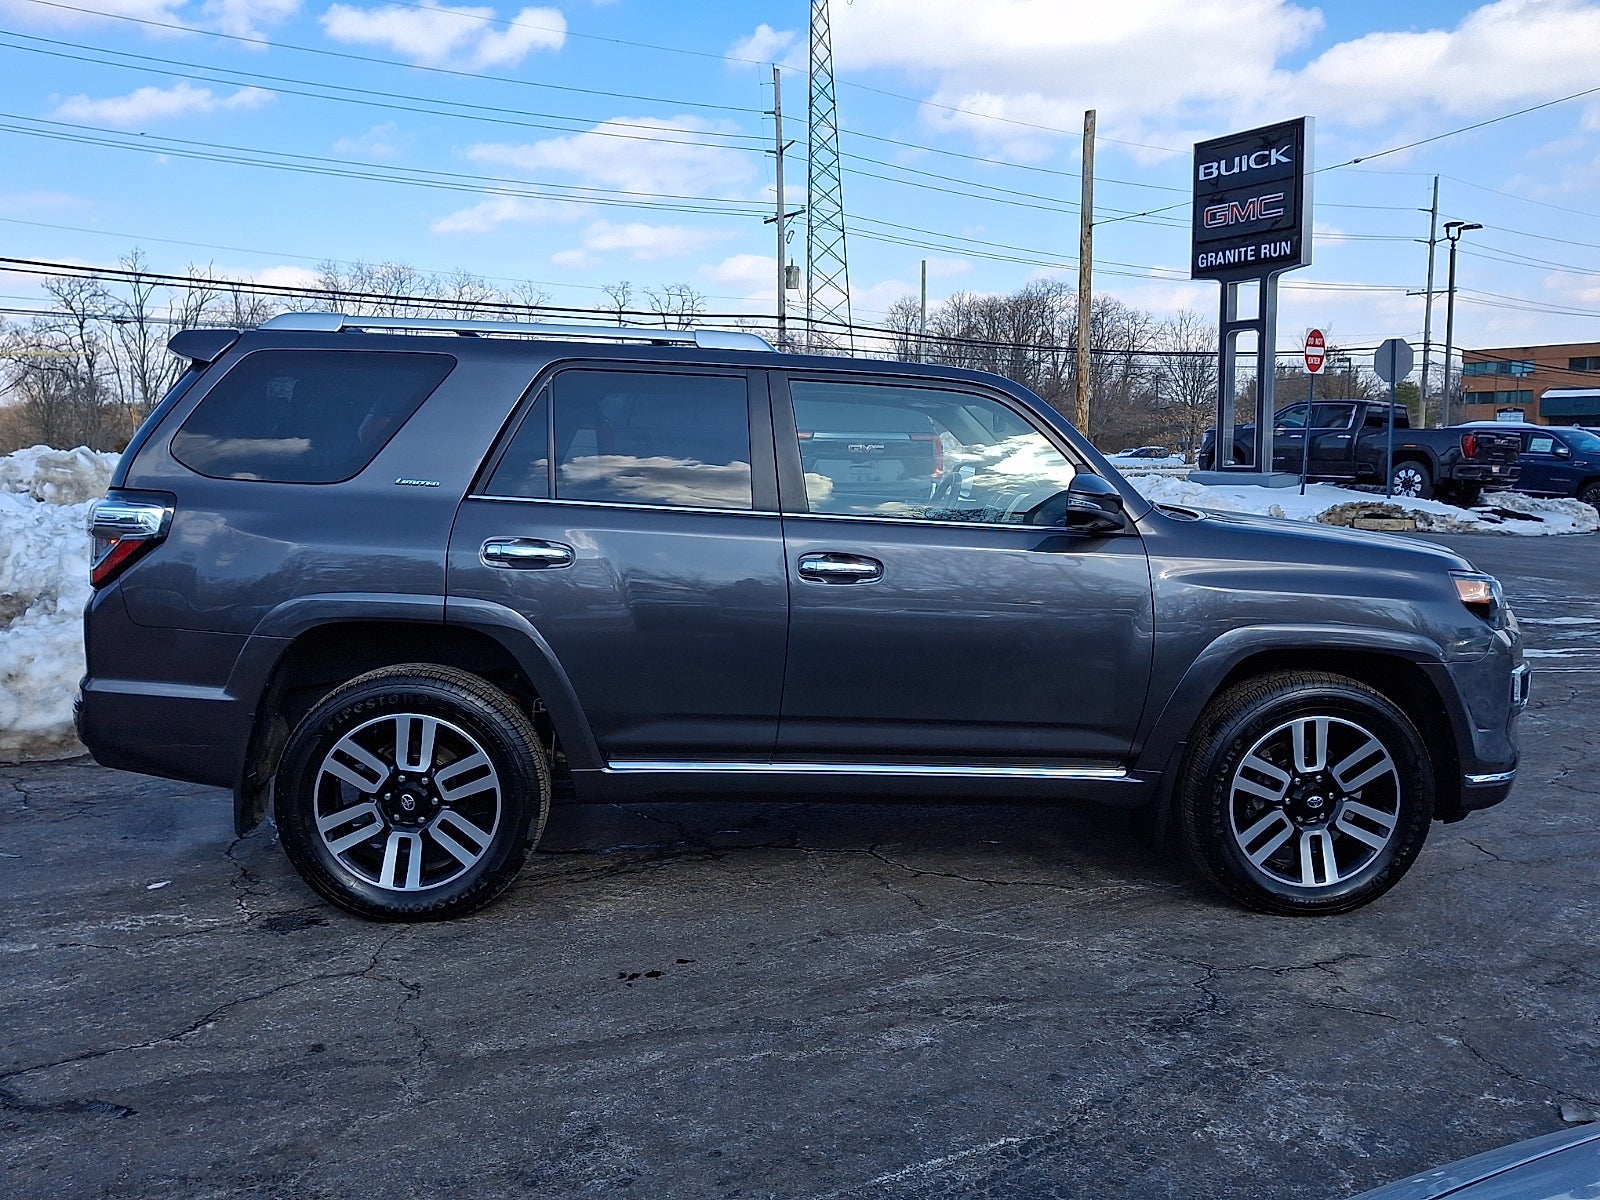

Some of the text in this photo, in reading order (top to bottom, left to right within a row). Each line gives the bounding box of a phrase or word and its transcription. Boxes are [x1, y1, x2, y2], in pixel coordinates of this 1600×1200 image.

[1198, 144, 1293, 181] BUICK
[1203, 192, 1285, 228] GMC
[1198, 240, 1291, 268] GRANITE RUN
[1308, 337, 1323, 345] DO NOT
[1308, 357, 1320, 365] ENTER
